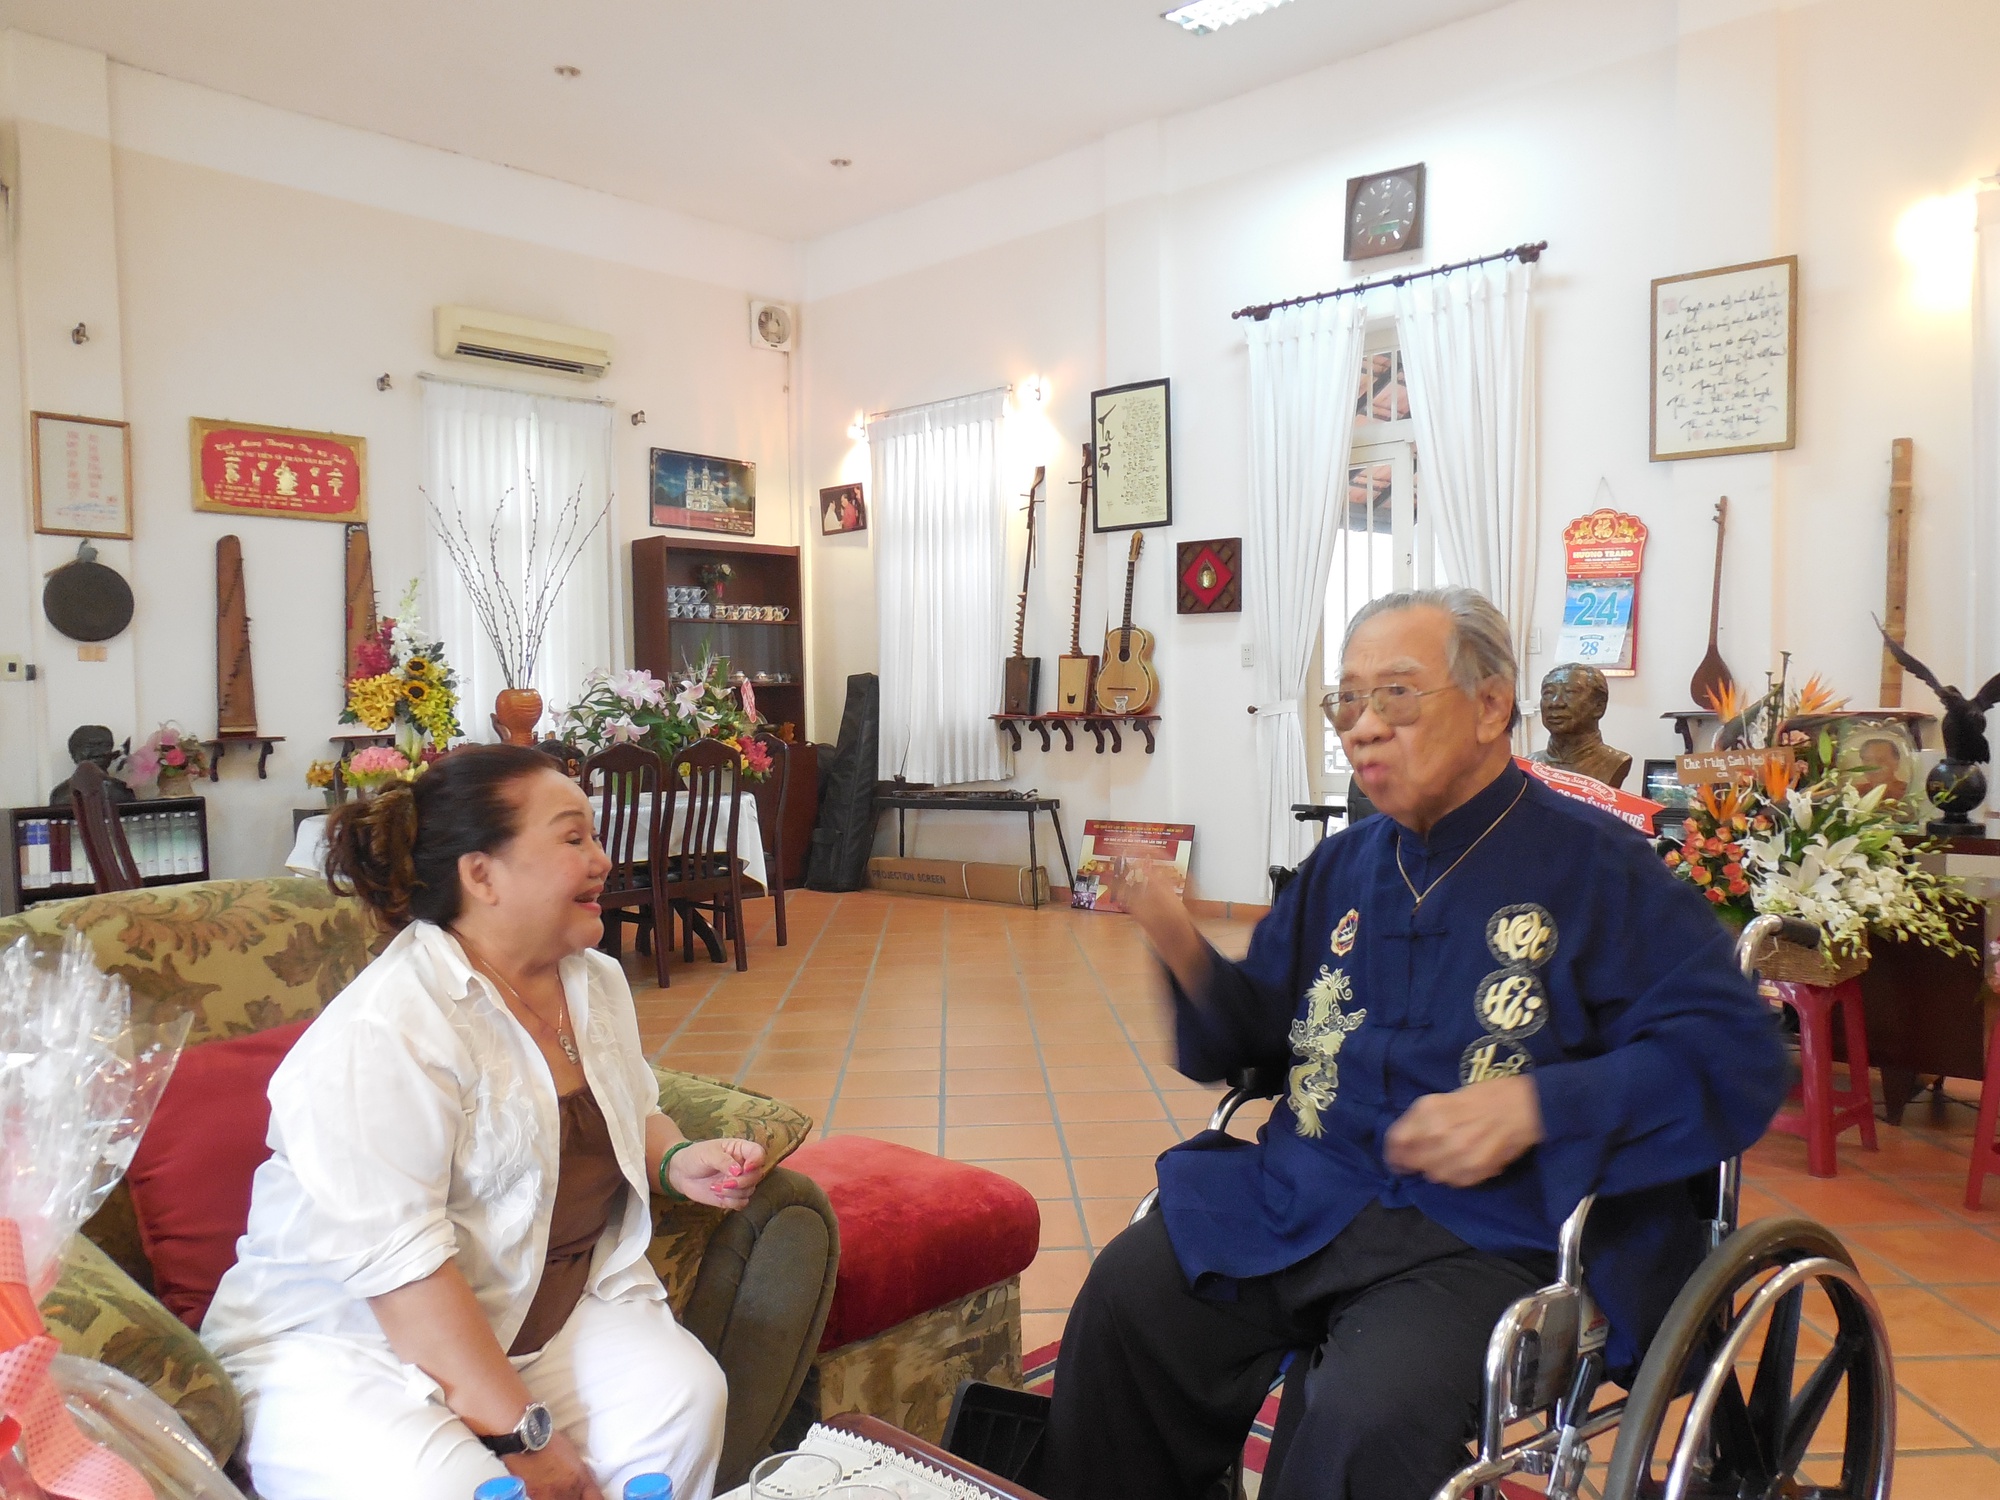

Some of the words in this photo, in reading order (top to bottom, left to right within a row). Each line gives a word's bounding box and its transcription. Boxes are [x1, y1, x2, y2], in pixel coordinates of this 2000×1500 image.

[1573, 591, 1619, 627] 24
[1579, 641, 1600, 656] 28
[1572, 776, 1588, 787] Sinh
[1622, 811, 1646, 830] KHÊ
[871, 869, 915, 881] PROJECTION
[917, 873, 947, 884] SCREEN
